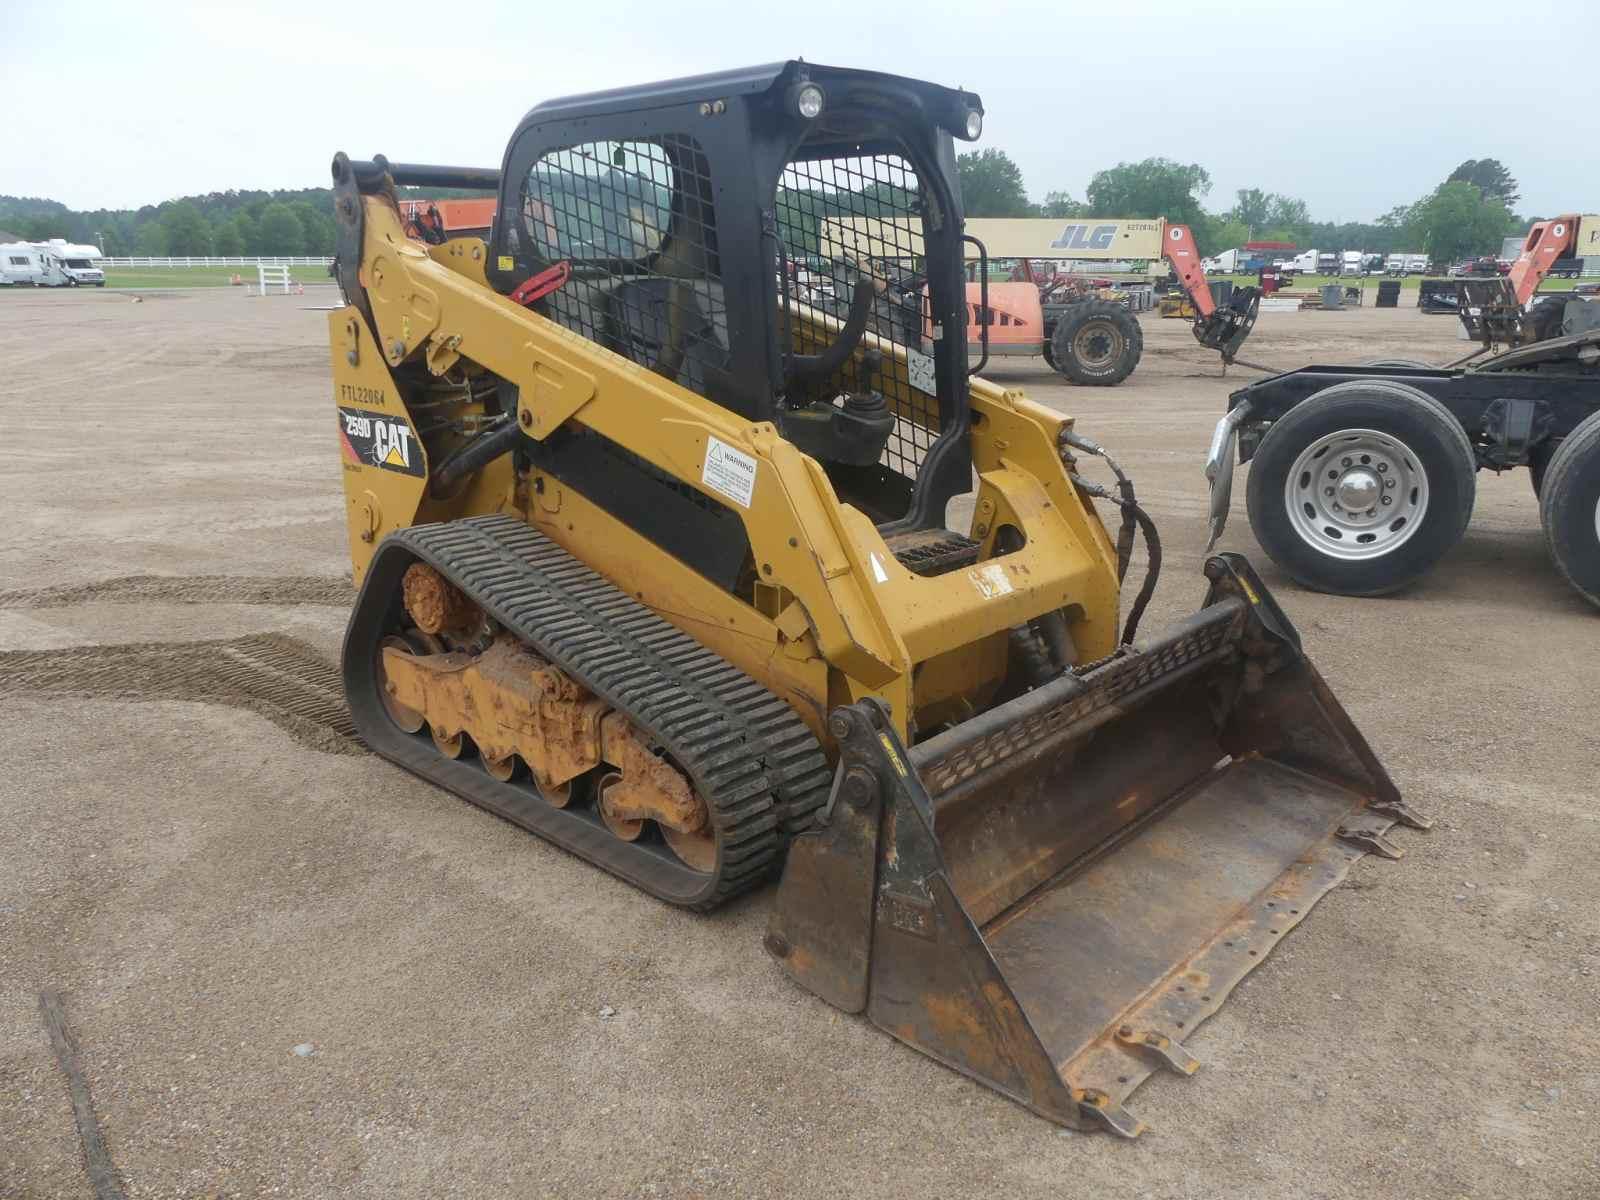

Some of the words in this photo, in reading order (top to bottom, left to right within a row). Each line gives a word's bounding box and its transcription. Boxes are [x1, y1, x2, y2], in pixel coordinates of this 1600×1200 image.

[1050, 224, 1118, 250] JLG
[346, 416, 371, 438] 259D
[374, 420, 411, 468] CAT
[724, 451, 753, 473] WARNING
